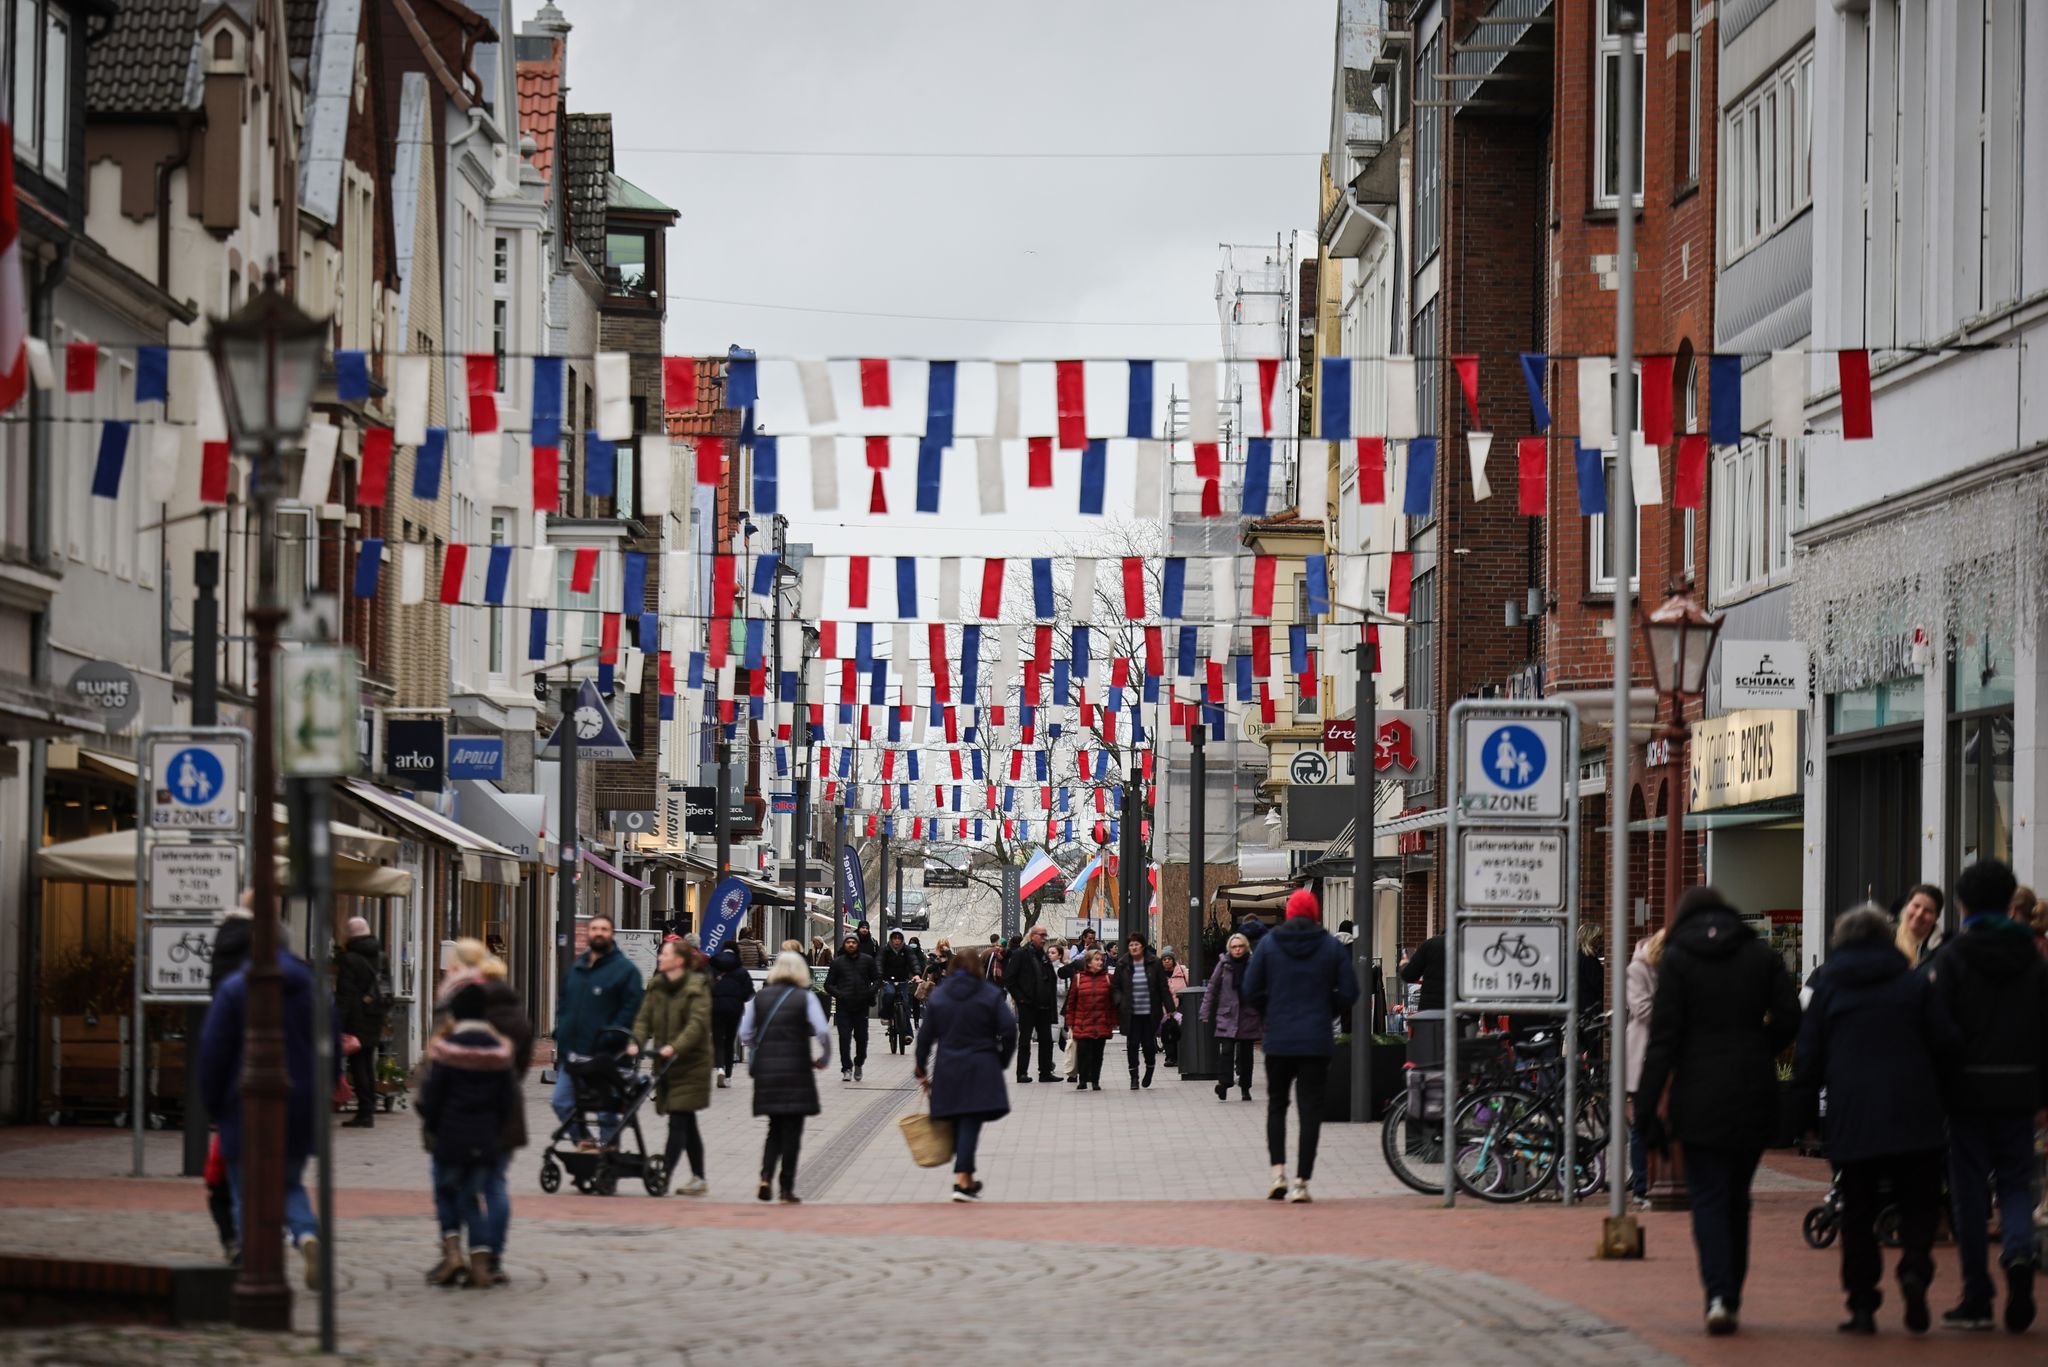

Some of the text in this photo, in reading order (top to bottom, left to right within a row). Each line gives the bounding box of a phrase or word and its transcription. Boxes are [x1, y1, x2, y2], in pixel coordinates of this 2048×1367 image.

[1736, 677, 1795, 687] SCHUBACK
[395, 750, 434, 769] arko
[452, 749, 499, 764] APOLLO
[1741, 720, 1774, 785] BOYENS
[1489, 795, 1538, 811] ZONE
[173, 811, 217, 825] ZONE
[667, 798, 678, 847] AKUSTIK
[1468, 841, 1556, 852] Lieferverkehr frei
[1483, 858, 1543, 871] werktags
[843, 854, 858, 898] freenet
[159, 968, 183, 984] frei
[1473, 971, 1498, 990] frei
